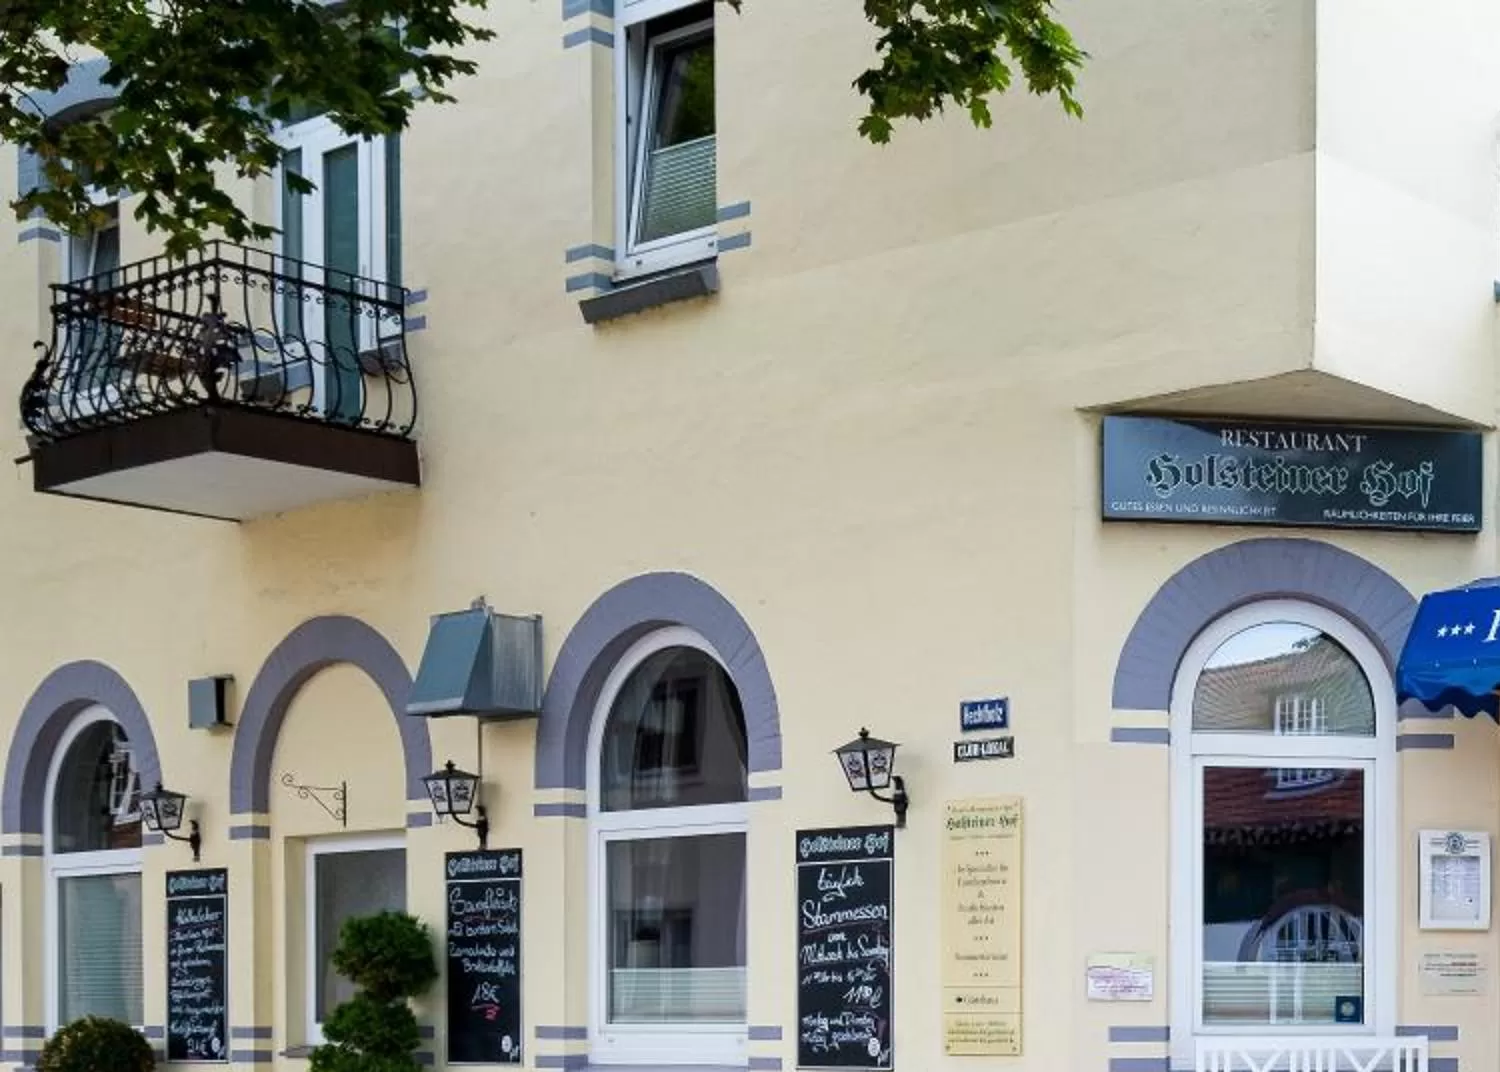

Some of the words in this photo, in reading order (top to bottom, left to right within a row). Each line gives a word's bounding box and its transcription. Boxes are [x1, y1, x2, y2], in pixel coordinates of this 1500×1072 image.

[1219, 428, 1369, 454] RESTAURANT
[1145, 450, 1351, 500] Holsteiner
[1358, 456, 1437, 509] Hof
[1110, 500, 1144, 512] GUTES
[1175, 503, 1199, 514] UND
